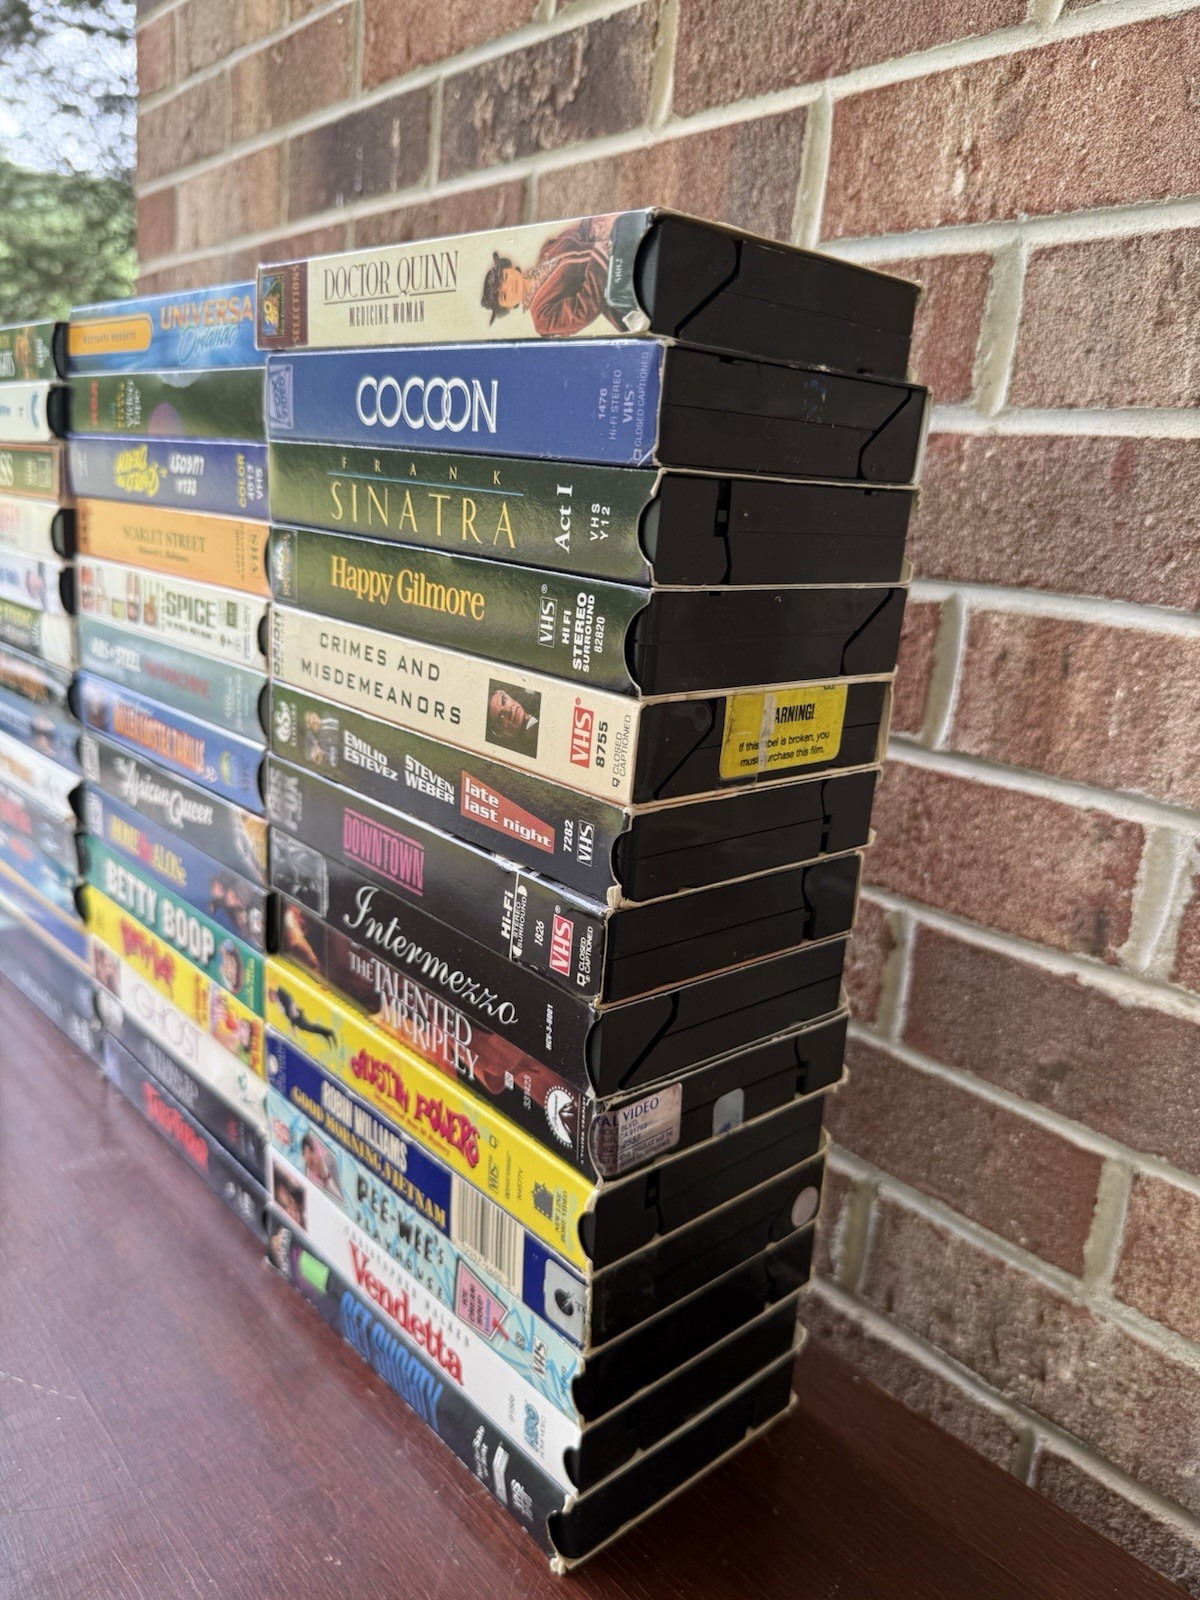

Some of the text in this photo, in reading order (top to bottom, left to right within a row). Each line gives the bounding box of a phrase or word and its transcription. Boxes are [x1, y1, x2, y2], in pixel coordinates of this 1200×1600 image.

[324, 250, 459, 301] DOCTOR QUINN
[160, 296, 255, 331] UNIVERSA
[292, 264, 301, 344] SELECTIONS
[349, 300, 425, 328] MEDICINE WOMAN
[356, 376, 499, 434] COCOON
[598, 388, 607, 420] 1476
[608, 369, 623, 441] Hi-Fi STEREO
[622, 391, 634, 424] VHS
[633, 352, 650, 448] CLOSED CAPTIONED
[236, 454, 247, 508] COLOR
[341, 456, 502, 486] FRANK
[330, 480, 517, 550] SINATRA
[554, 484, 573, 554] Act I
[590, 503, 601, 541] VHS
[164, 590, 217, 628] SPICE
[330, 554, 394, 605] Happy
[397, 568, 486, 622] Gilmore
[539, 599, 555, 645] VHS
[561, 609, 572, 644] HI FI
[572, 592, 587, 671] STEREO
[583, 594, 596, 673] SURROUND
[594, 616, 606, 653] 82820
[319, 632, 441, 683] CRIMES AND
[301, 658, 461, 726] MISDEMEANORS
[775, 703, 815, 724] ARNING!
[343, 729, 388, 767] EMILIO
[571, 711, 592, 766] VHS
[595, 720, 608, 768] 8755
[612, 731, 623, 778] CLOSED
[619, 714, 632, 778] CAPTIONED
[746, 741, 759, 752] this
[816, 731, 830, 743] you
[796, 746, 809, 757] this
[343, 748, 398, 782] ESTEVEZ
[405, 755, 455, 794] STEVEN
[405, 773, 455, 805] WEBER
[169, 789, 214, 829] Queen
[465, 777, 500, 808] late
[464, 796, 553, 849] last night
[563, 819, 574, 853] 7282
[577, 823, 593, 863] VHS
[343, 811, 425, 889] DOWNTOWN
[104, 857, 158, 925] BETTY
[162, 898, 216, 967] BOOP
[500, 889, 515, 940] Hi-Fi
[517, 896, 528, 949] SURROUND
[534, 919, 546, 946] 1826
[343, 884, 519, 1025] Intermezzo
[551, 919, 573, 973] VHS
[578, 932, 587, 968] CLOSED
[584, 925, 594, 974] CAPTIONED
[348, 951, 472, 1047] THE TALENTED
[412, 1011, 480, 1081] RIPLEY
[414, 1090, 480, 1169] POWERS
[623, 1097, 659, 1123] VIDEO
[353, 1104, 408, 1174] WILLIAMS
[489, 1163, 499, 1192] VHS
[357, 1173, 445, 1265] PEE-WEE'S
[356, 1210, 443, 1301] PLAYHOUSE
[349, 1238, 464, 1387] Vendetta
[533, 1341, 547, 1376] VHS
